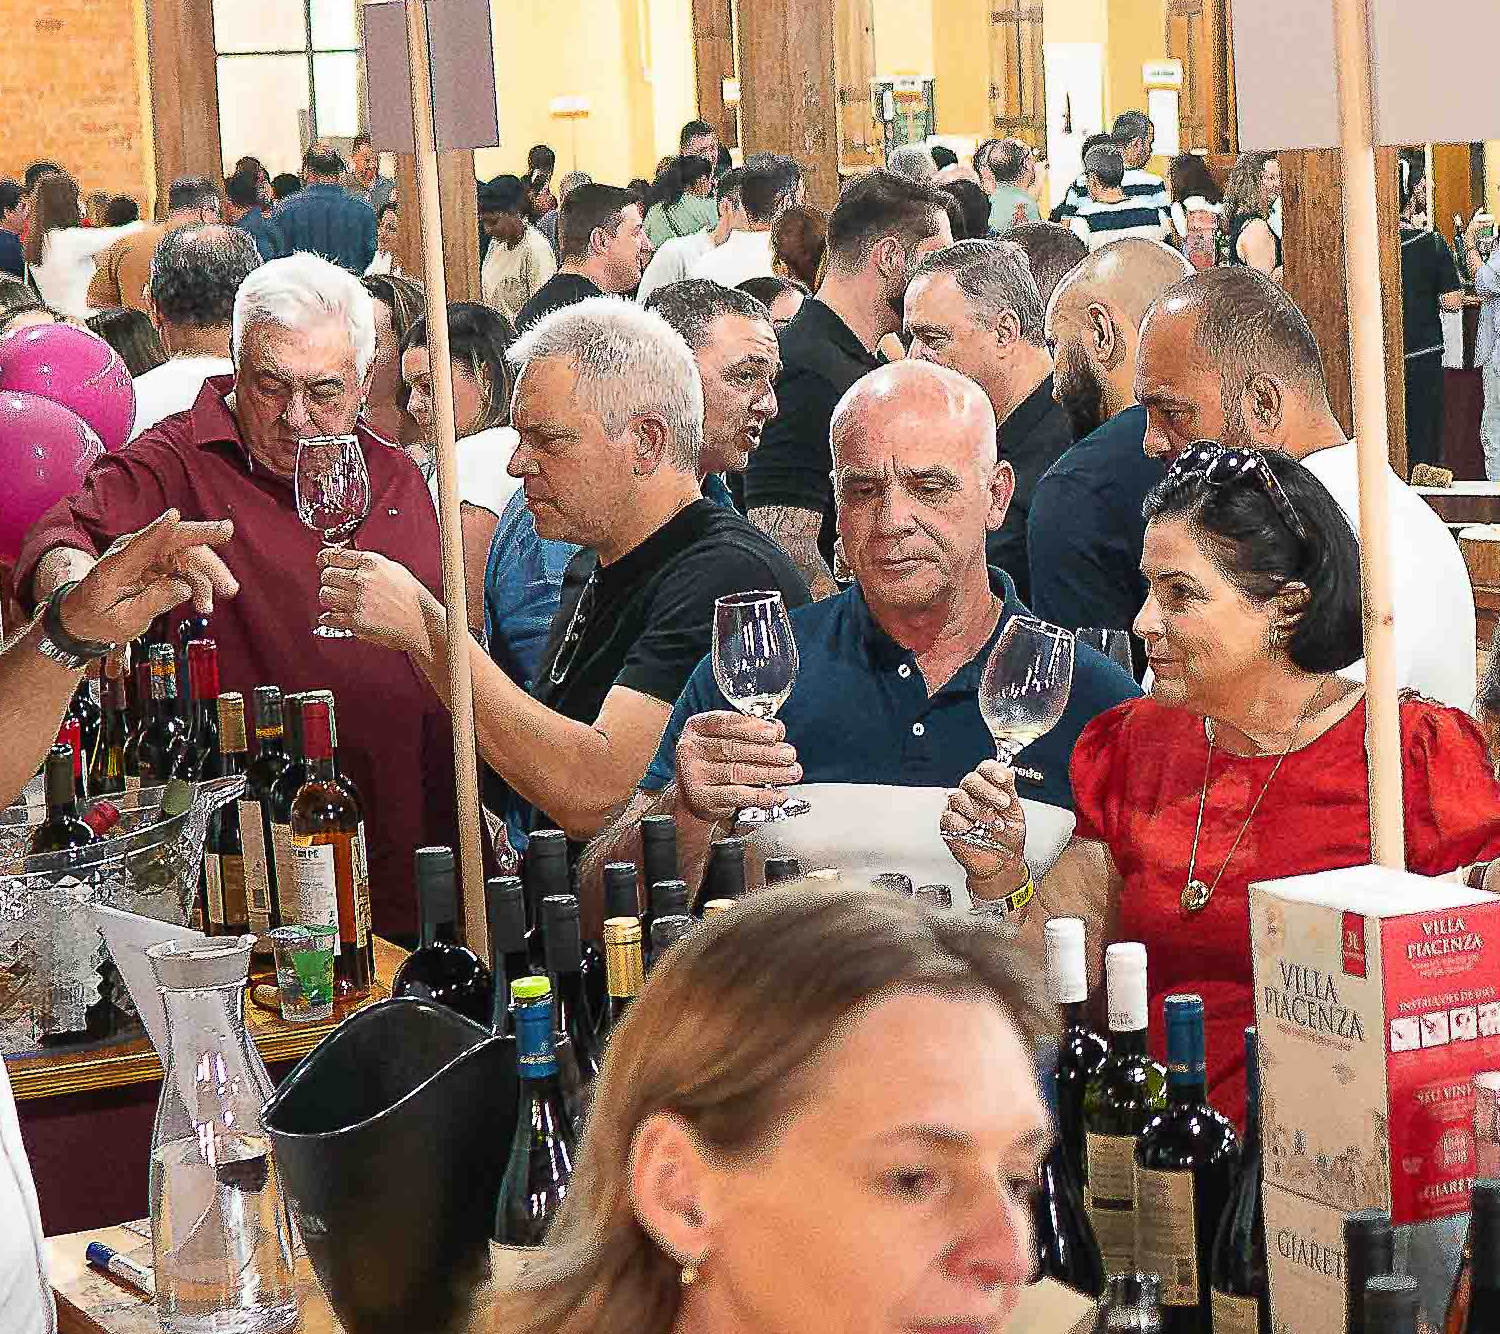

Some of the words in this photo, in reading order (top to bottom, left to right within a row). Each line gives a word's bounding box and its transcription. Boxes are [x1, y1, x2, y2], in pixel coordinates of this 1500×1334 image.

[1422, 917, 1467, 936] VILLA
[1406, 933, 1484, 959] PIACENZA
[1280, 960, 1338, 1004] VILLA
[1264, 986, 1366, 1042] PIACENZA
